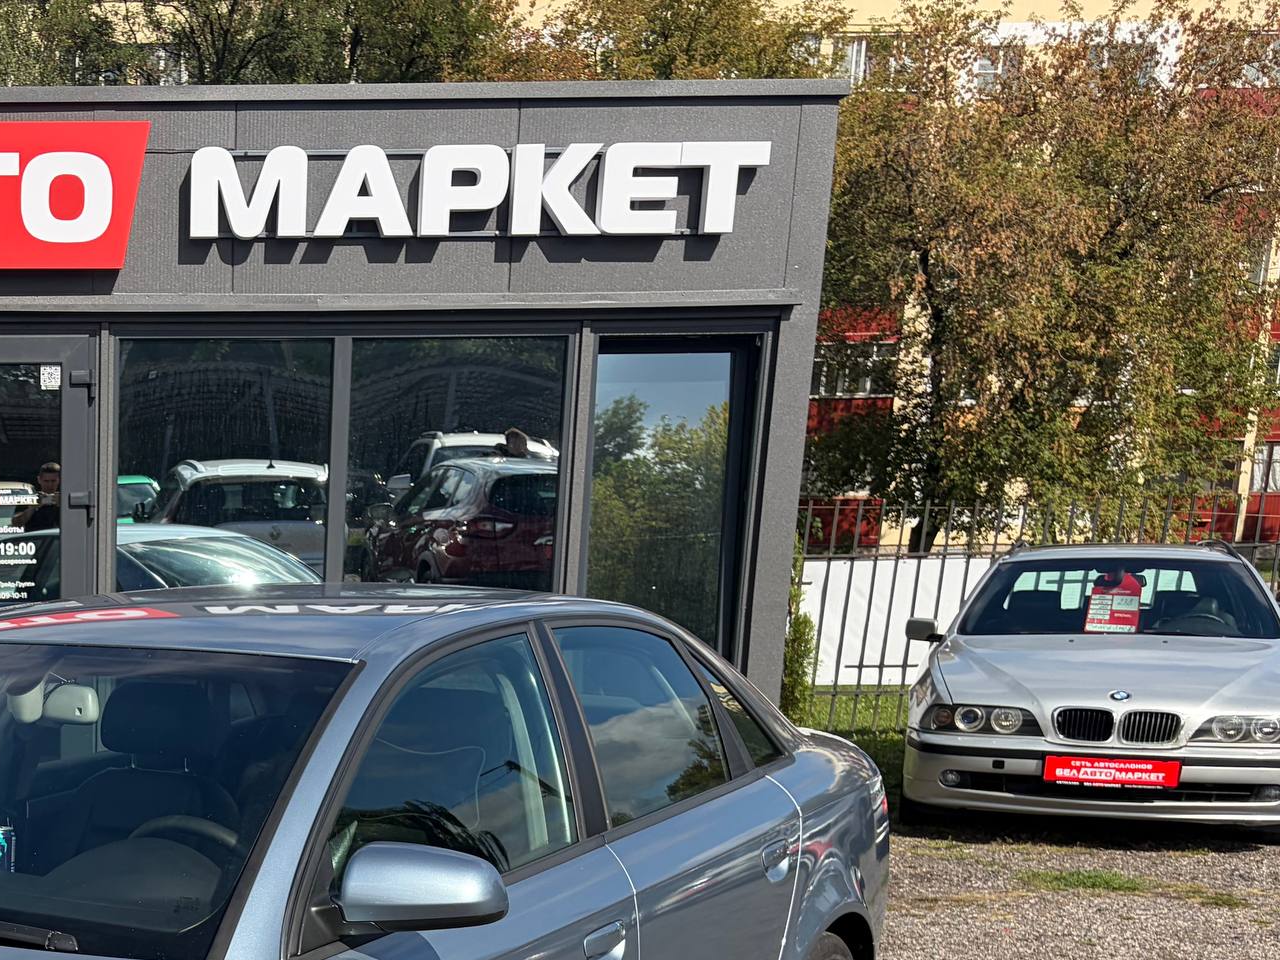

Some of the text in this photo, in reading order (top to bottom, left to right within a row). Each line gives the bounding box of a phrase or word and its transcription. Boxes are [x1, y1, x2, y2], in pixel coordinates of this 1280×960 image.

[189, 141, 771, 239] МАРКЕТ
[0, 496, 39, 505] МАРКЕТ
[1093, 761, 1153, 769] АВТОСАЛОНОВ
[1056, 768, 1166, 781] БЕЛ АВТО МАРКЕТ
